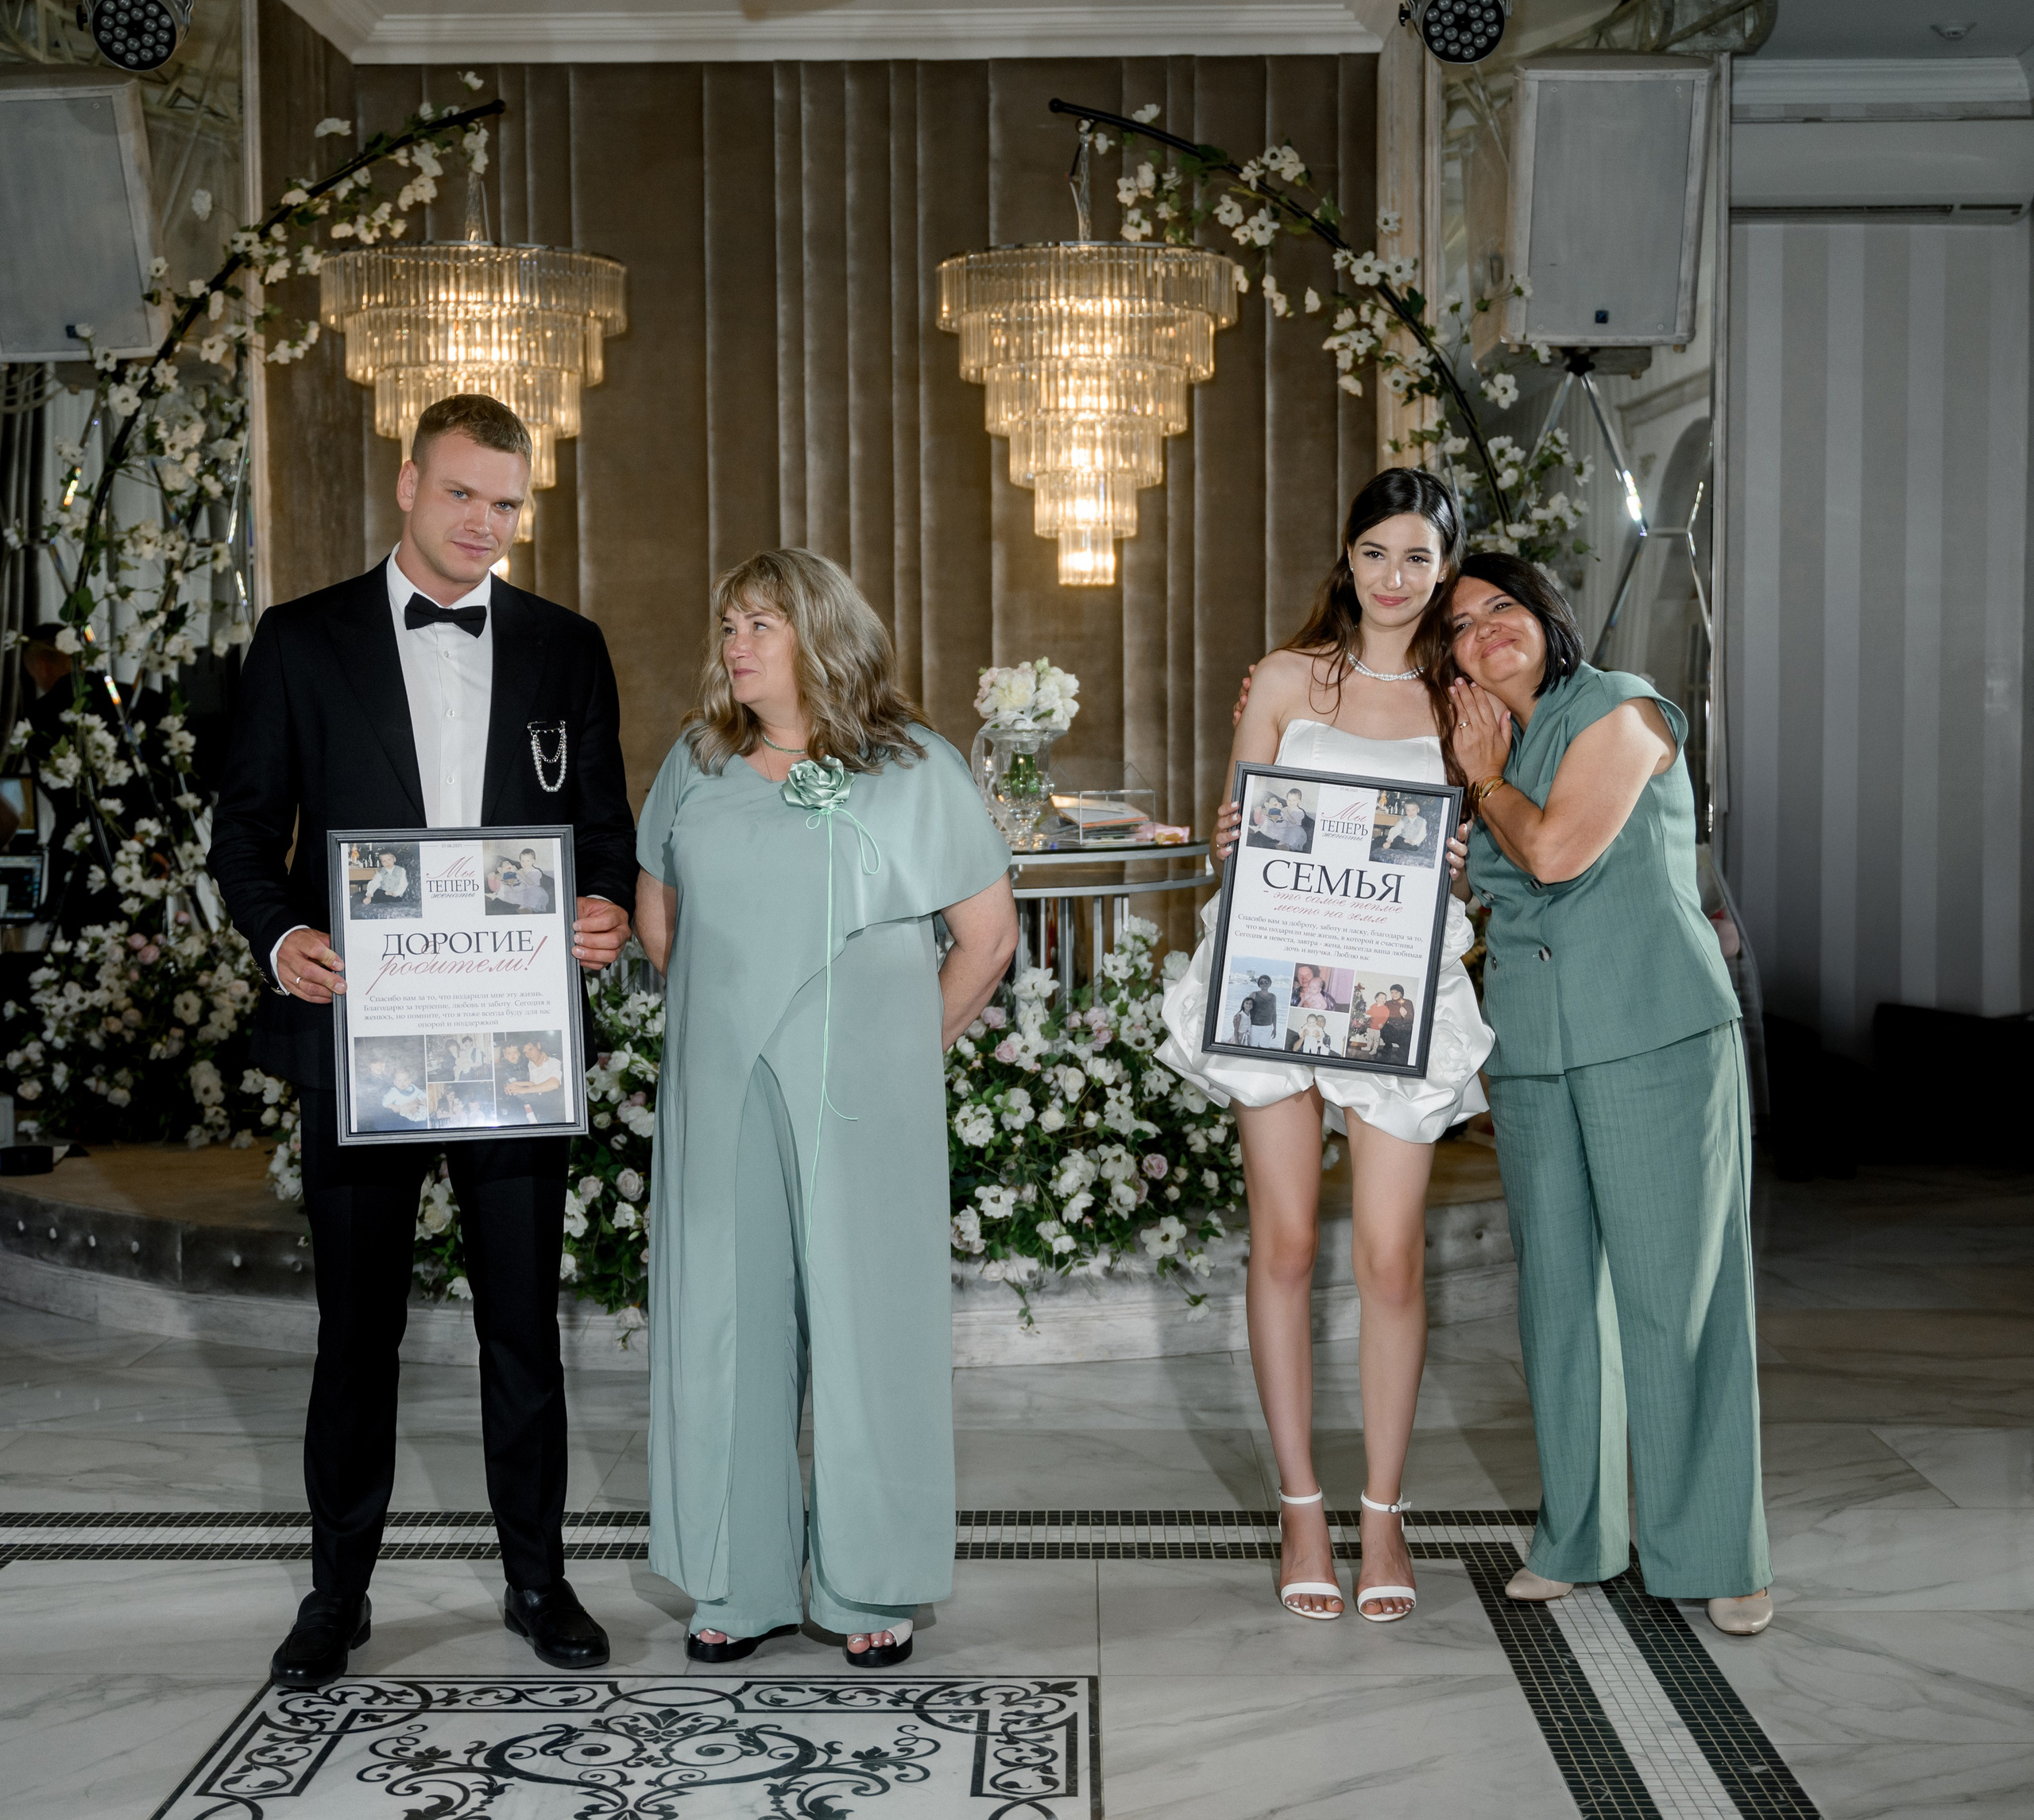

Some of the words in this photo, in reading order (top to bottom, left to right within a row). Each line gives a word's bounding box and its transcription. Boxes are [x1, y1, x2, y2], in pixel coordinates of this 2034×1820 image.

[1321, 802, 1368, 822] Мы
[1320, 819, 1368, 837] ТЕПЕРЬ
[1321, 833, 1363, 841] женаты
[426, 856, 475, 879] Мы
[426, 879, 480, 892] ТЕПЕРЬ
[1263, 859, 1406, 904] СЕМЬЯ
[1274, 891, 1301, 901] это
[1305, 895, 1347, 906] самое
[1350, 901, 1403, 914] теплое
[1274, 904, 1321, 916] место
[1324, 910, 1344, 919] на
[1347, 914, 1388, 924] земле
[1289, 921, 1318, 929] доброту,
[1320, 924, 1341, 933] заботу
[381, 929, 534, 960] ДОРОГИЕ
[1235, 930, 1263, 939] Сегодня
[1297, 938, 1318, 948] завтра
[1343, 944, 1372, 953] навсегда
[1391, 950, 1422, 959] любимая
[1380, 941, 1413, 949] счастлива
[365, 936, 548, 995] родители!
